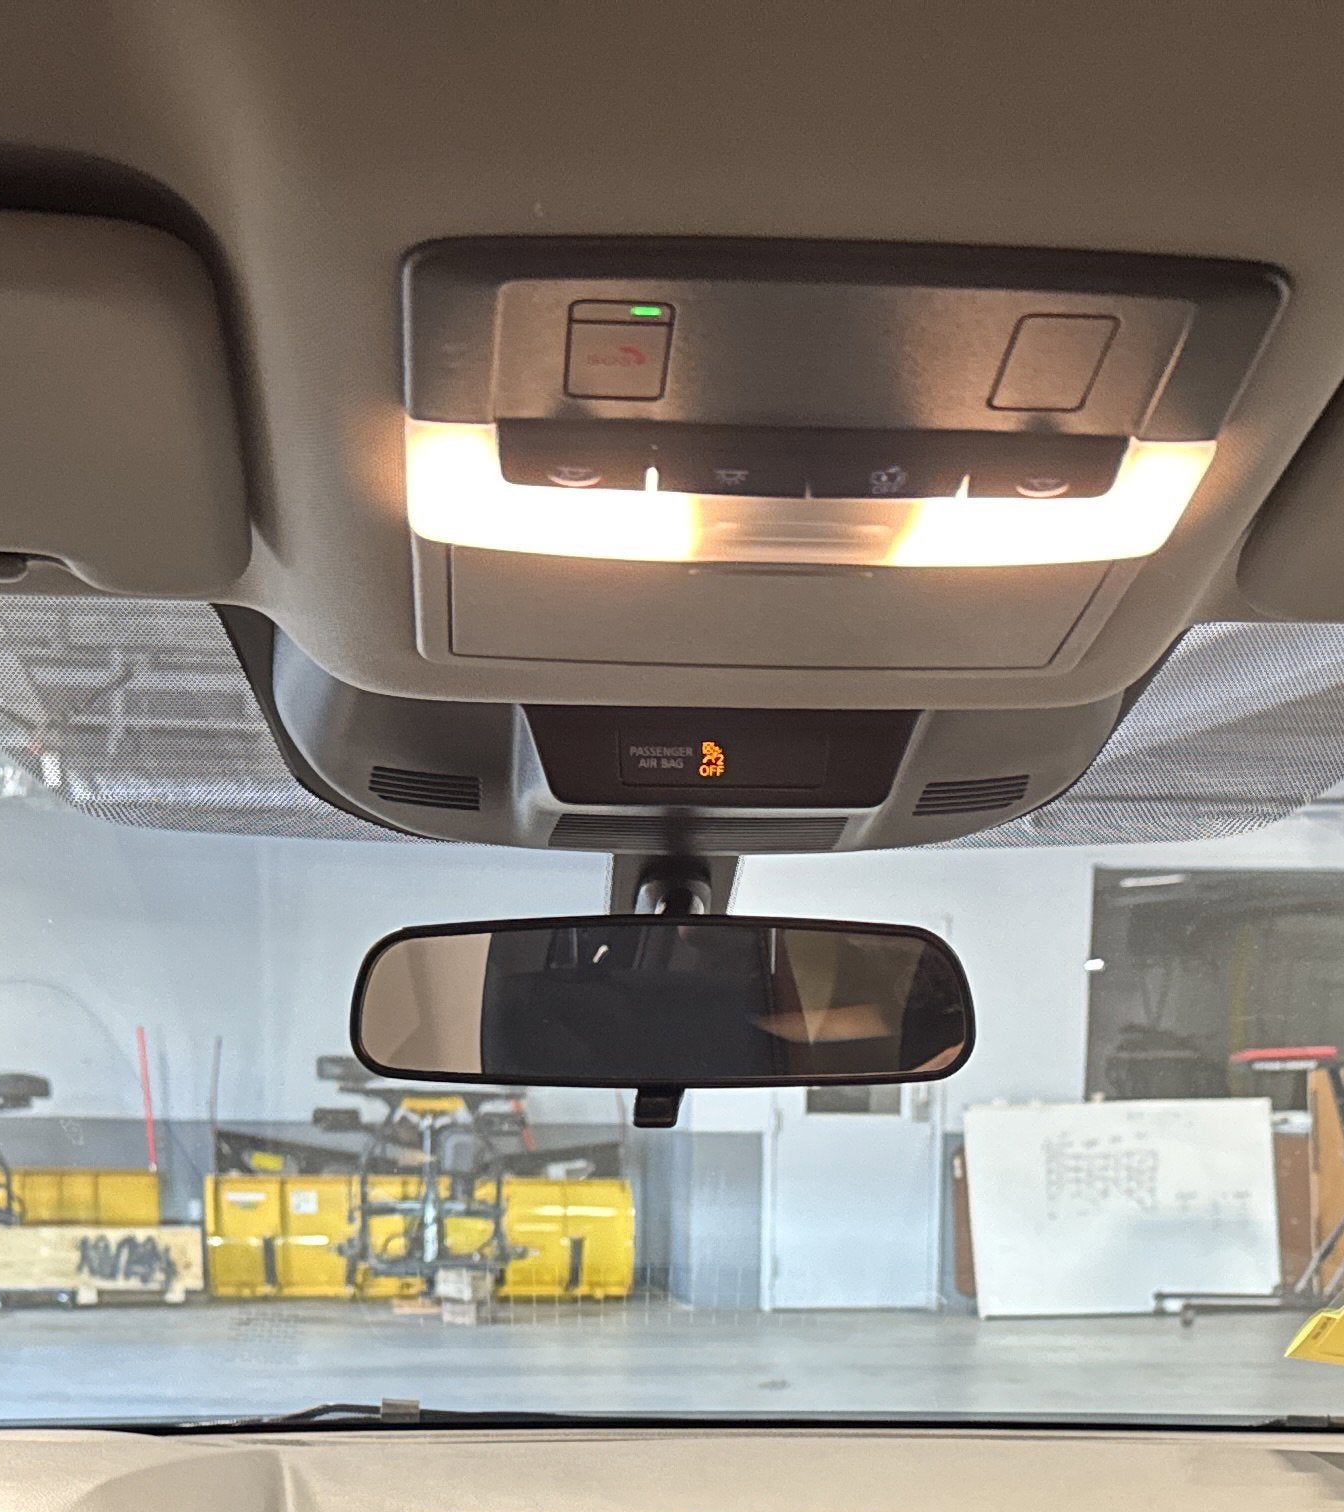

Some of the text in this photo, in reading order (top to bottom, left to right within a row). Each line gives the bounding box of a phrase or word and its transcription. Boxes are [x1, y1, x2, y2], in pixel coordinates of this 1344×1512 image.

[629, 746, 693, 757] PASSENGER
[638, 758, 684, 769] AIR BAG
[698, 764, 725, 777] OFF
